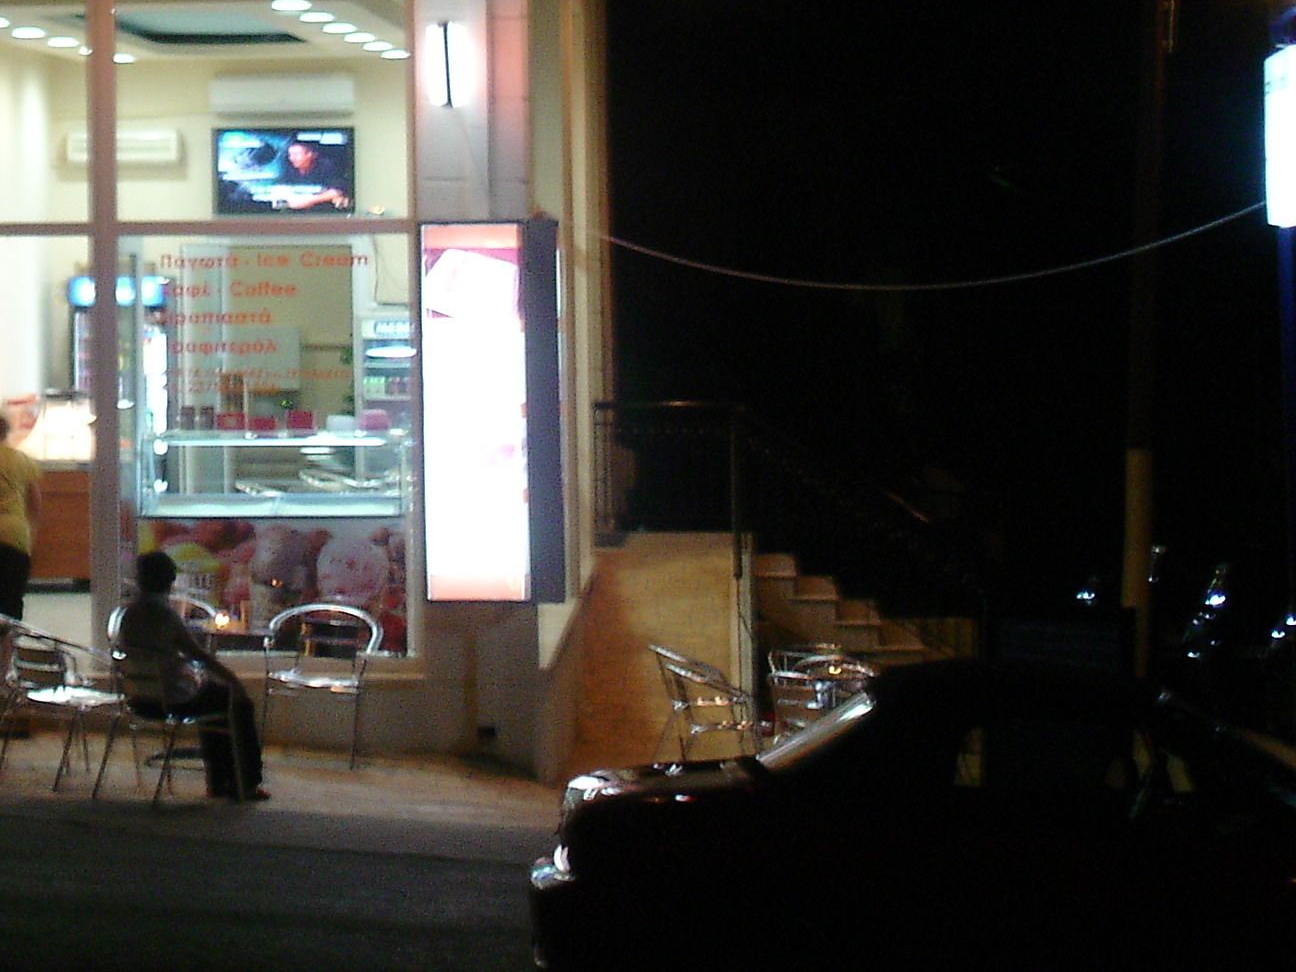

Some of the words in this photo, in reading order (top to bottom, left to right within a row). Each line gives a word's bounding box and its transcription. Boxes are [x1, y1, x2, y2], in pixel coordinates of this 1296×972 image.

[257, 253, 289, 268] Ice
[300, 251, 369, 268] Cream
[229, 280, 297, 297] Coffee
